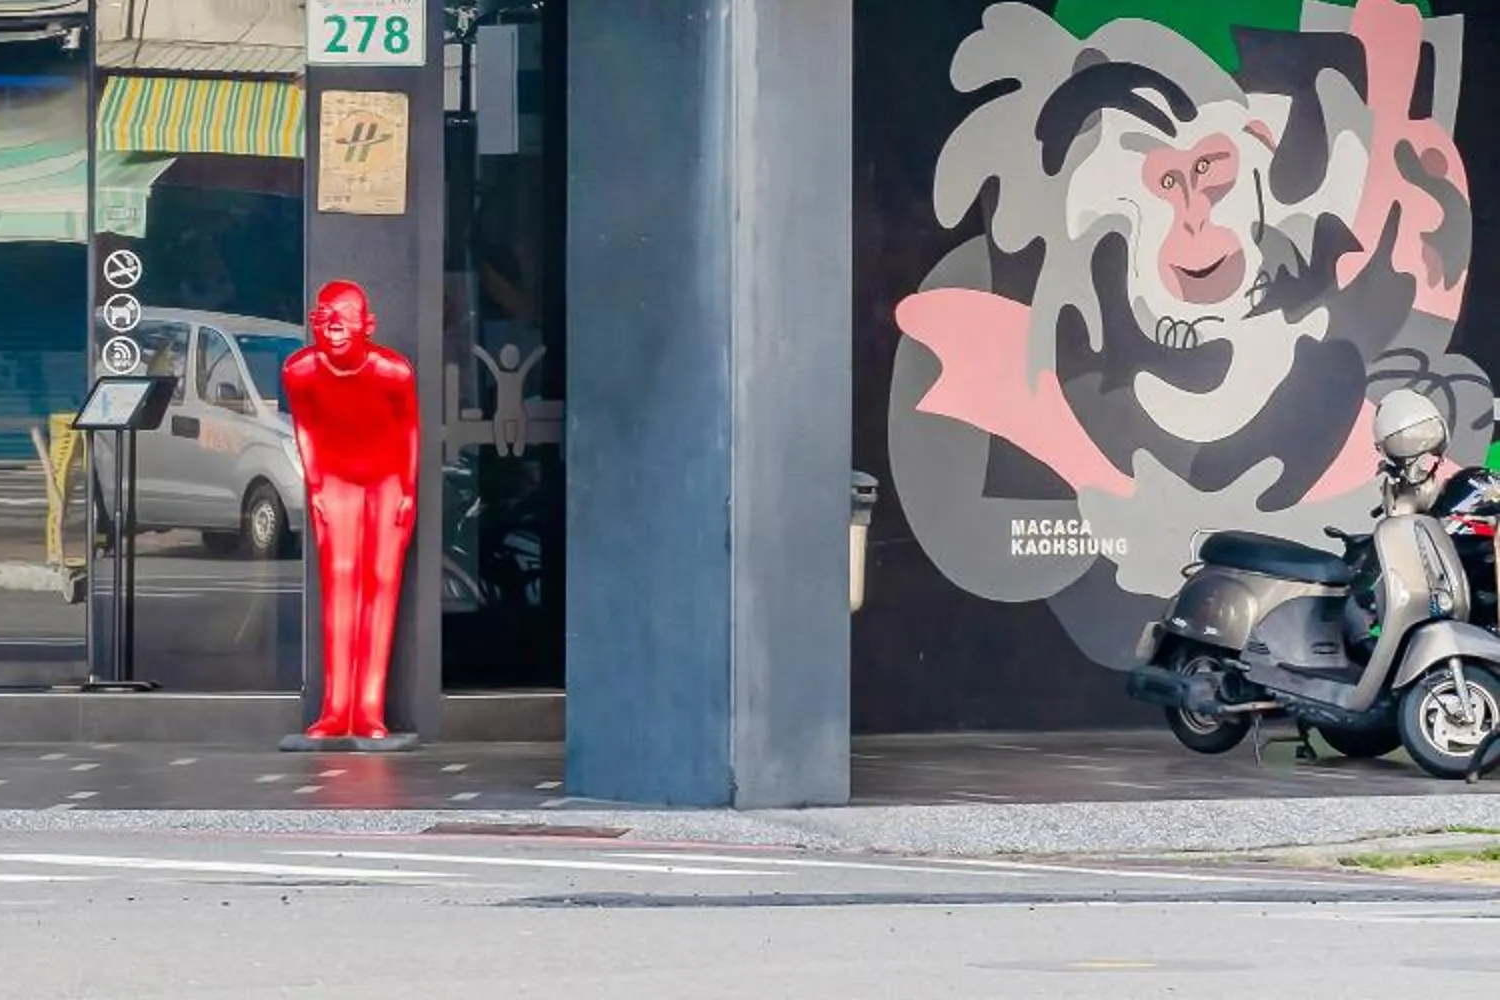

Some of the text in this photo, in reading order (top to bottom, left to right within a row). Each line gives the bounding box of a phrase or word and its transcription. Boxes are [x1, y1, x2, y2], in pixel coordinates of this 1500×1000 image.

[323, 14, 410, 54] 278
[1011, 519, 1093, 536] MACACA
[1011, 537, 1128, 556] KAOHSIUNG
